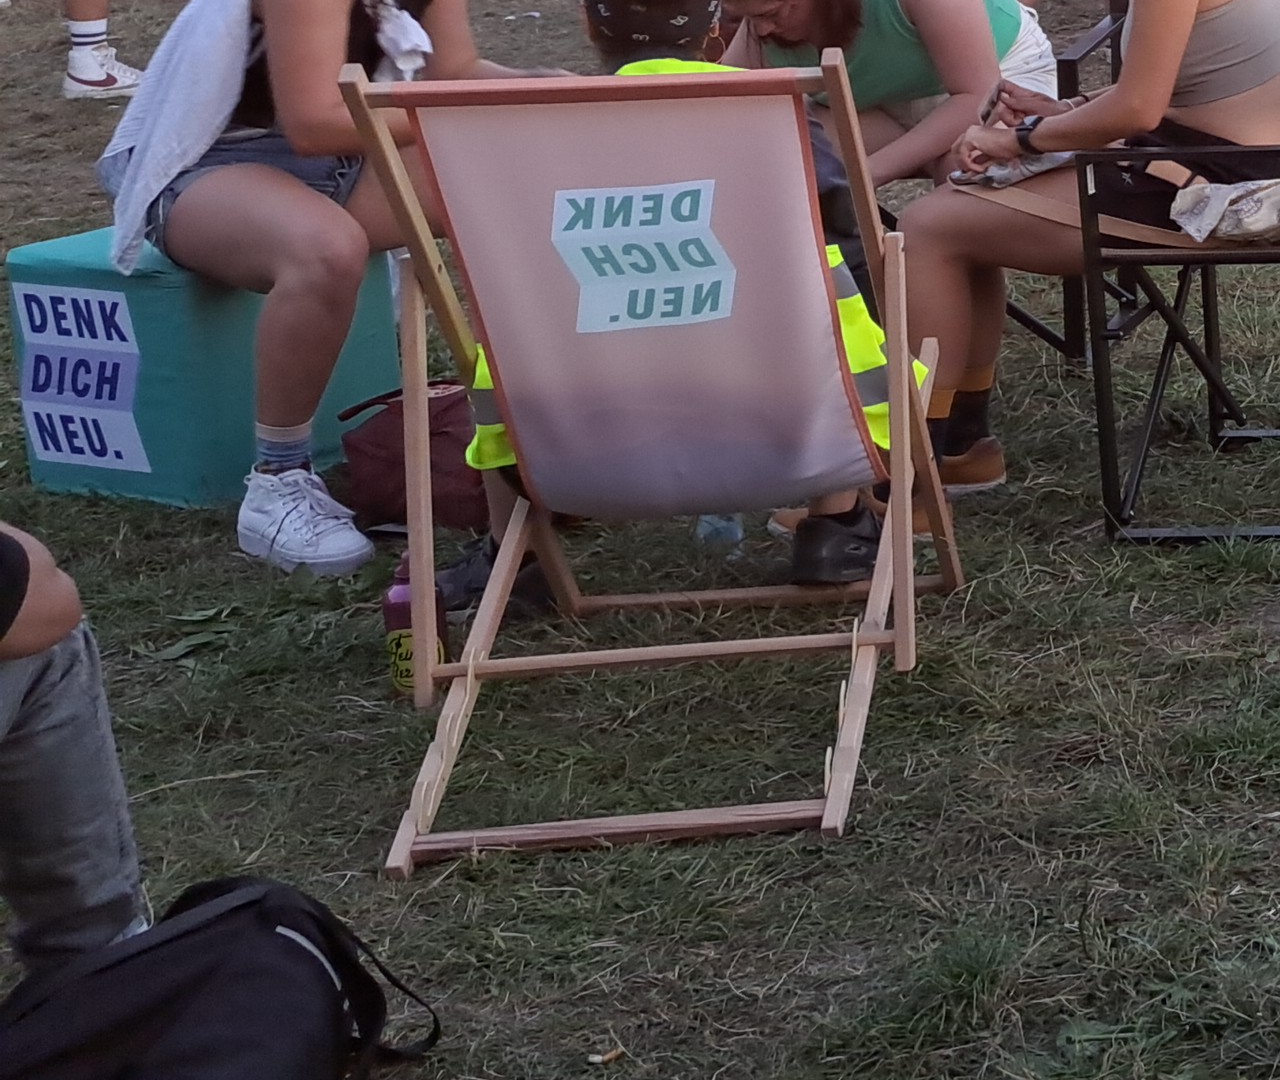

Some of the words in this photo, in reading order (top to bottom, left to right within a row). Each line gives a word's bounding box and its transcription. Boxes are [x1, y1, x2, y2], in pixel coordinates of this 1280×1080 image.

[23, 293, 129, 343] DENK
[31, 354, 121, 401] DICH
[33, 411, 124, 460] NEU.
